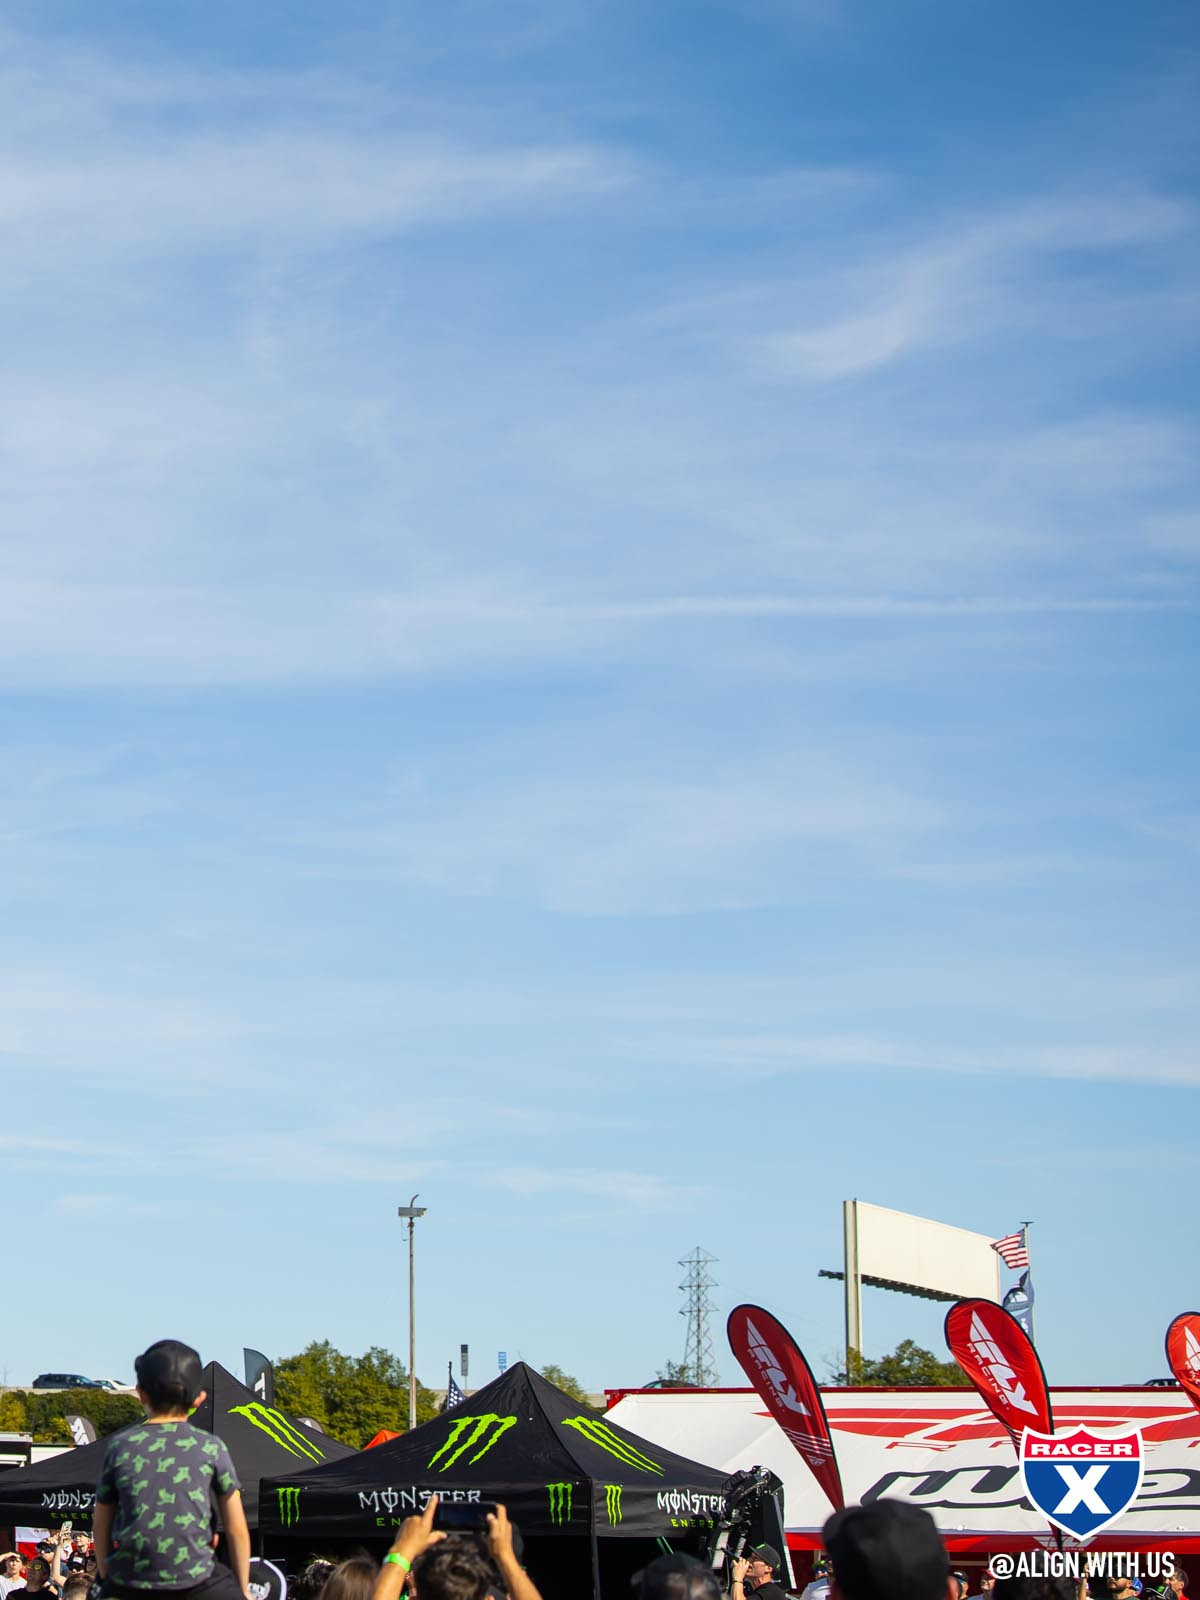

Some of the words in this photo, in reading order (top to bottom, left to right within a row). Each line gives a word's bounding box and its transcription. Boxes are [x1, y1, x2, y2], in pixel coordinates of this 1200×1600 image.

[748, 1348, 785, 1408] RACING
[749, 1336, 812, 1417] FLY
[966, 1342, 1009, 1406] RACING
[970, 1333, 1039, 1416] FLY
[50, 1512, 96, 1520] ENER
[358, 1486, 481, 1513] MONSTER
[657, 1488, 727, 1515] MONSTER
[671, 1518, 714, 1529] ENERG
